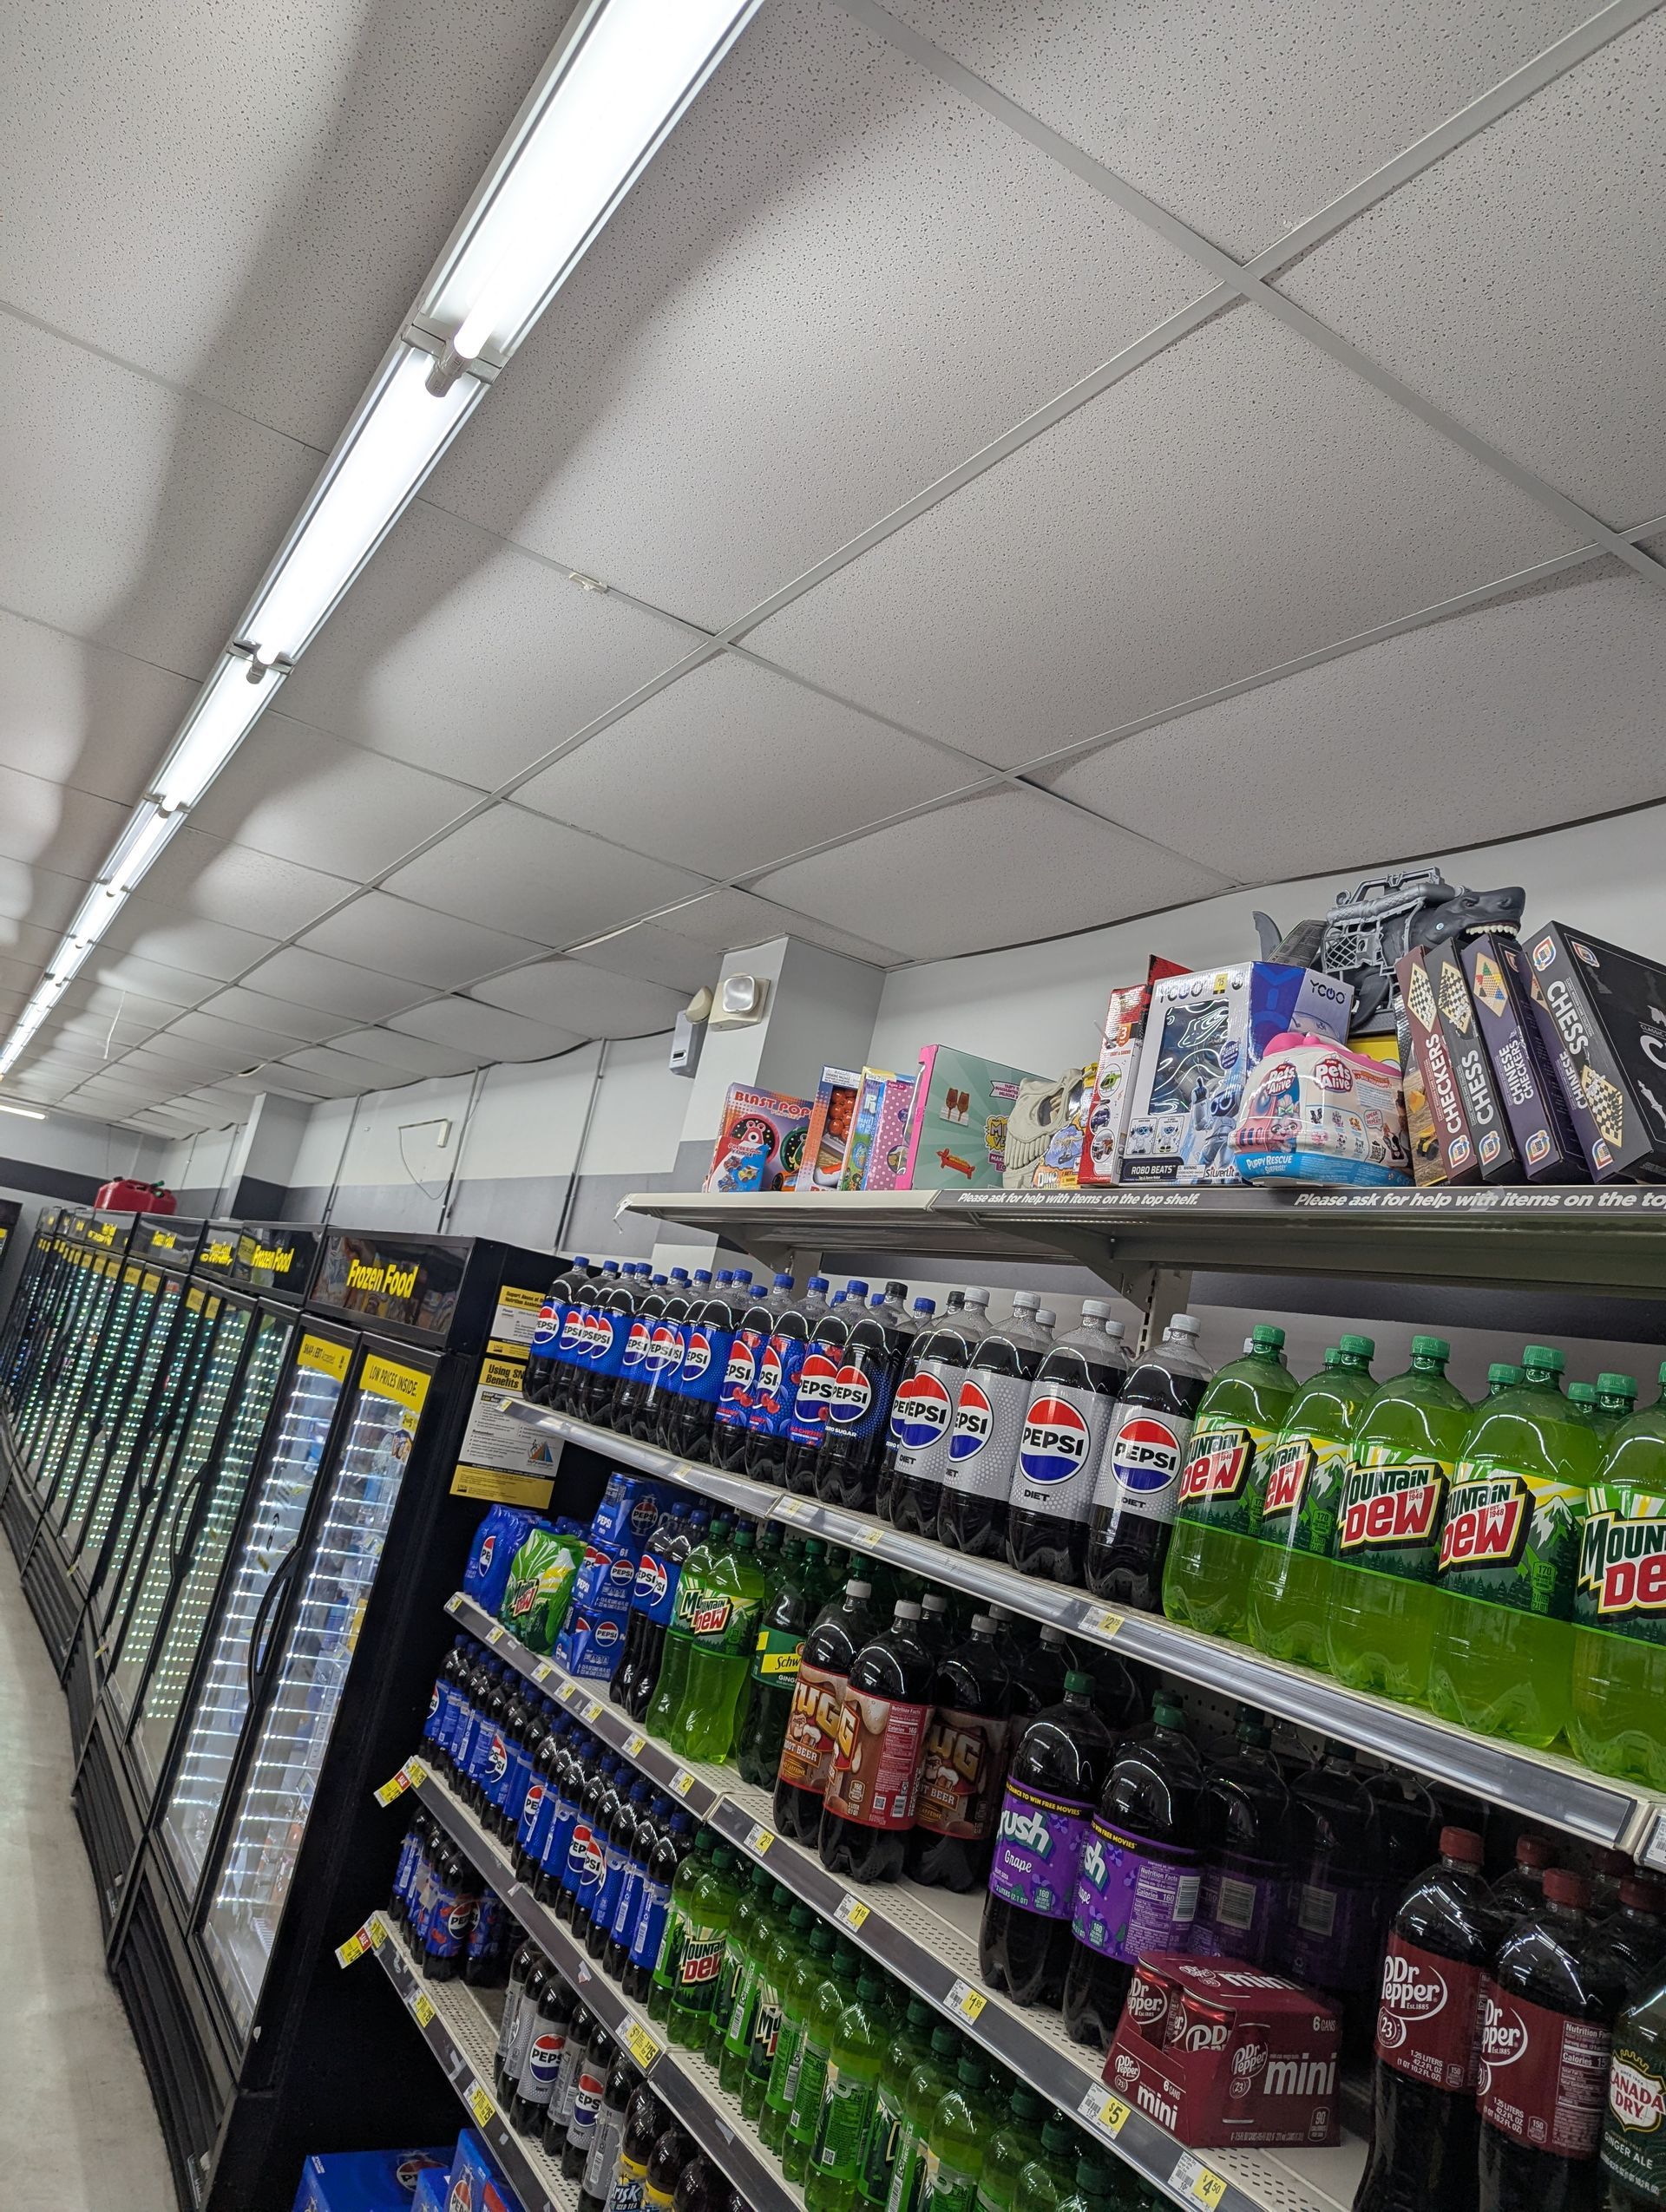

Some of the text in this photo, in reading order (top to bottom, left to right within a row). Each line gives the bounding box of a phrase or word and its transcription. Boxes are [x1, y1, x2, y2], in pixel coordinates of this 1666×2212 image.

[1547, 980, 1589, 1055] CHESS
[1270, 1067, 1295, 1081] Pets
[1315, 1064, 1350, 1079] Pets
[1499, 1044, 1525, 1105] CHINESE
[1509, 1040, 1534, 1099] CHECKERS
[1322, 1078, 1352, 1090] Alive
[1426, 1033, 1462, 1133] CHECKERS
[1462, 1050, 1494, 1125] CHESS
[734, 1090, 814, 1120] BLAST POP
[1131, 1166, 1151, 1175] ROBO
[1246, 1155, 1293, 1170] PUPPY RESCUE
[957, 1193, 1201, 1206] Please ask for help with items on the top shelf.
[1295, 1192, 1666, 1209] Please ask for help with items on the to
[251, 1245, 276, 1271] Frozen
[272, 1247, 295, 1273] Food
[347, 1260, 420, 1299] Frozen Food
[370, 1365, 380, 1383] LOW
[381, 1368, 397, 1389] PRICES
[489, 1364, 511, 1378] Using
[486, 1374, 520, 1389] Benefits
[801, 1380, 833, 1398] PEPS
[907, 1399, 948, 1424] EPSI
[835, 1427, 857, 1437] SUGAR
[954, 1411, 987, 1435] EPSI
[1023, 1427, 1084, 1456] PEPSI
[899, 1454, 917, 1466] DIET
[1115, 1444, 1177, 1471] PEPSI
[1024, 1489, 1050, 1502] DIET
[1122, 1496, 1147, 1508] DIET
[1408, 1493, 1423, 1502] 1948
[597, 1514, 613, 1529] PEPSI
[633, 1510, 657, 1522] PEPSI
[1317, 1512, 1329, 1521] 170
[1489, 1507, 1505, 1518] 1948
[612, 1568, 633, 1577] PEPSI
[1538, 1566, 1552, 1577] 170
[1604, 1554, 1666, 1607] De
[575, 1578, 590, 1593] PEPSI
[597, 1629, 617, 1639] PEPSI
[797, 1744, 818, 1763] BEER
[928, 1724, 982, 1783] UG
[930, 1788, 955, 1806] BEER
[1022, 1792, 1030, 1801] TO
[1030, 1795, 1041, 1805] WIN
[1041, 1800, 1056, 1810] FREE
[998, 1810, 1050, 1854] rush
[1102, 1828, 1113, 1840] FREE
[1004, 1849, 1033, 1874] Grape
[1140, 1867, 1178, 1882] Nutrition Facts
[999, 1887, 1011, 1899] LITERS
[1039, 1888, 1050, 1899] 160
[1137, 1888, 1175, 1903] Calories 160
[1093, 1922, 1103, 1934] 160
[1393, 1956, 1420, 1984] Dr
[1134, 1977, 1150, 1994] Dr
[1217, 1972, 1304, 1991] mini
[1484, 1998, 1503, 2026] Dr
[1313, 2016, 1335, 2032] 6 CANS
[1381, 2016, 1394, 2039] 23
[1565, 2023, 1598, 2039] Nutrition
[1244, 2043, 1261, 2060] Dr
[1411, 2049, 1443, 2068] 1.25 LITERS
[1563, 2052, 1593, 2067] Calories
[1116, 2054, 1139, 2077] Pepper
[1124, 2056, 1134, 2068] Dr
[1233, 2047, 1267, 2076] Pepper
[1413, 2058, 1426, 2069] 42.2
[1426, 2063, 1433, 2071] FL
[1450, 2065, 1461, 2075] 150
[1263, 2052, 1338, 2095] mini
[1397, 2058, 1441, 2084] (1 QT 10.2 FL OZ)
[1163, 2080, 1181, 2100] 6 CANS
[1233, 2081, 1244, 2093] 23
[1610, 2066, 1665, 2112] CANADA
[1108, 2101, 1123, 2125] $5
[1137, 2084, 1179, 2131] mini
[1493, 2097, 1525, 2119] 1.25 LITERS
[1615, 2090, 1644, 2121] DRY
[1315, 2111, 1327, 2125] 90
[1486, 2108, 1523, 2136] QT 10.2 FL OZ)
[1495, 2105, 1525, 2126] 42.2 FL OZ
[1532, 2119, 1545, 2130] 150
[1604, 2130, 1631, 2158] GINGER
[1633, 2152, 1654, 2170] ALE
[611, 2184, 641, 2203] risk
